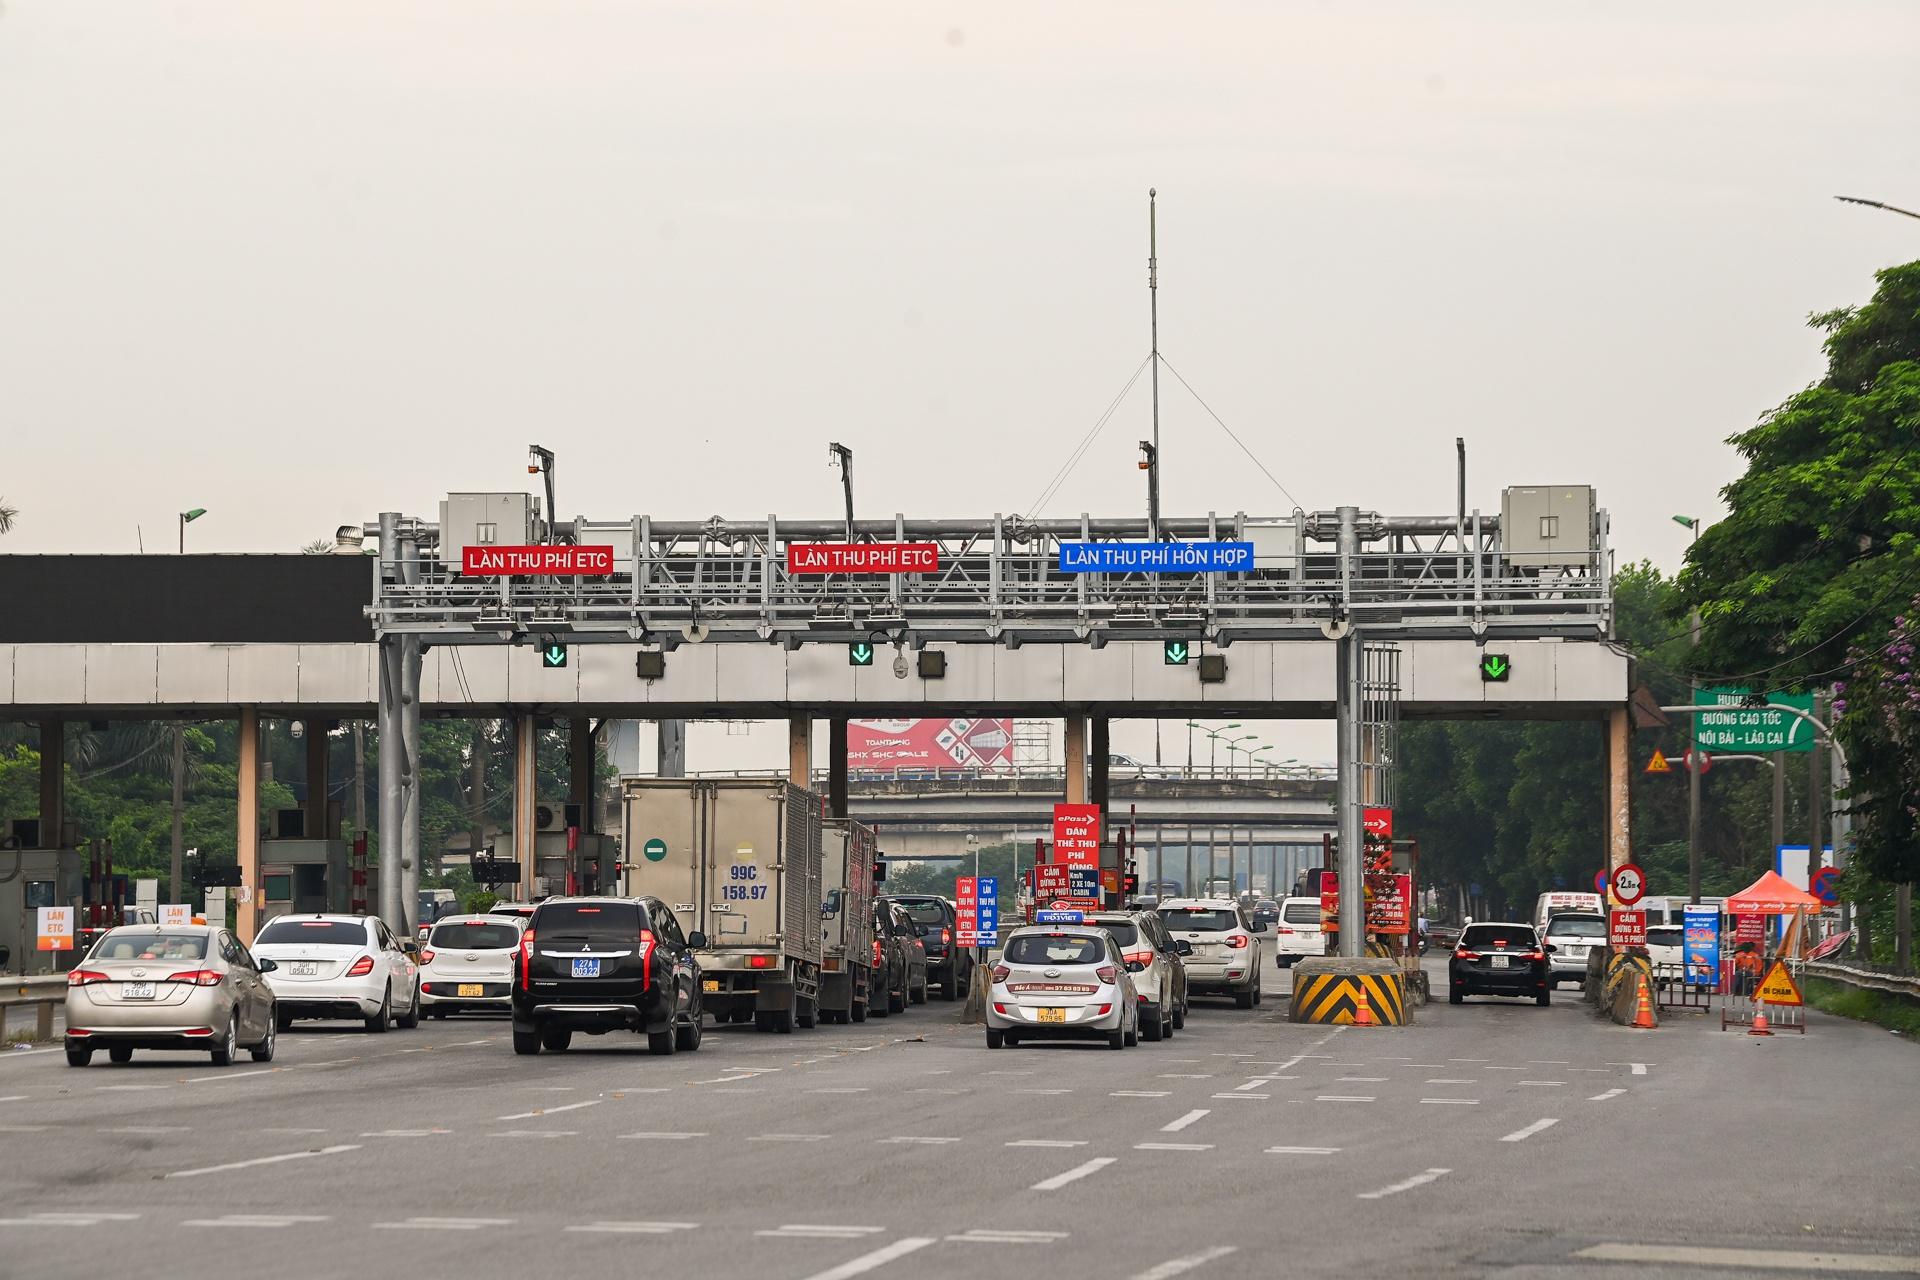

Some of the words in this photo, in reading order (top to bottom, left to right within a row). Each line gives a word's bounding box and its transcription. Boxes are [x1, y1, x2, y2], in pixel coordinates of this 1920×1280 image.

[469, 549, 504, 568] LÀN
[507, 553, 541, 568] THU
[545, 549, 574, 568] PHÍ
[577, 553, 607, 568] ETC
[795, 548, 827, 566] LÀN
[832, 551, 865, 566] THU
[870, 548, 897, 565] PHÍ
[902, 550, 932, 565] ETC
[1066, 546, 1099, 564] LÀN
[1104, 550, 1136, 564] THU
[1141, 546, 1170, 564] PHÍ
[1173, 543, 1207, 564] HỖN
[1214, 548, 1247, 566] HỢP
[1702, 710, 1737, 725] ĐƯỜNG
[1740, 713, 1759, 725] CAO
[1762, 709, 1781, 725] TỐC
[1699, 730, 1715, 745] NỘI
[1719, 730, 1734, 744] BÀI
[1745, 730, 1764, 744] LÀO
[1767, 732, 1783, 744] CAI
[1066, 827, 1087, 835] DÁN
[1068, 851, 1085, 859] PHÍ
[731, 866, 756, 880] 99C
[722, 886, 767, 899] 158.97
[47, 924, 64, 933] ETC
[1630, 934, 1644, 943] PHÚT
